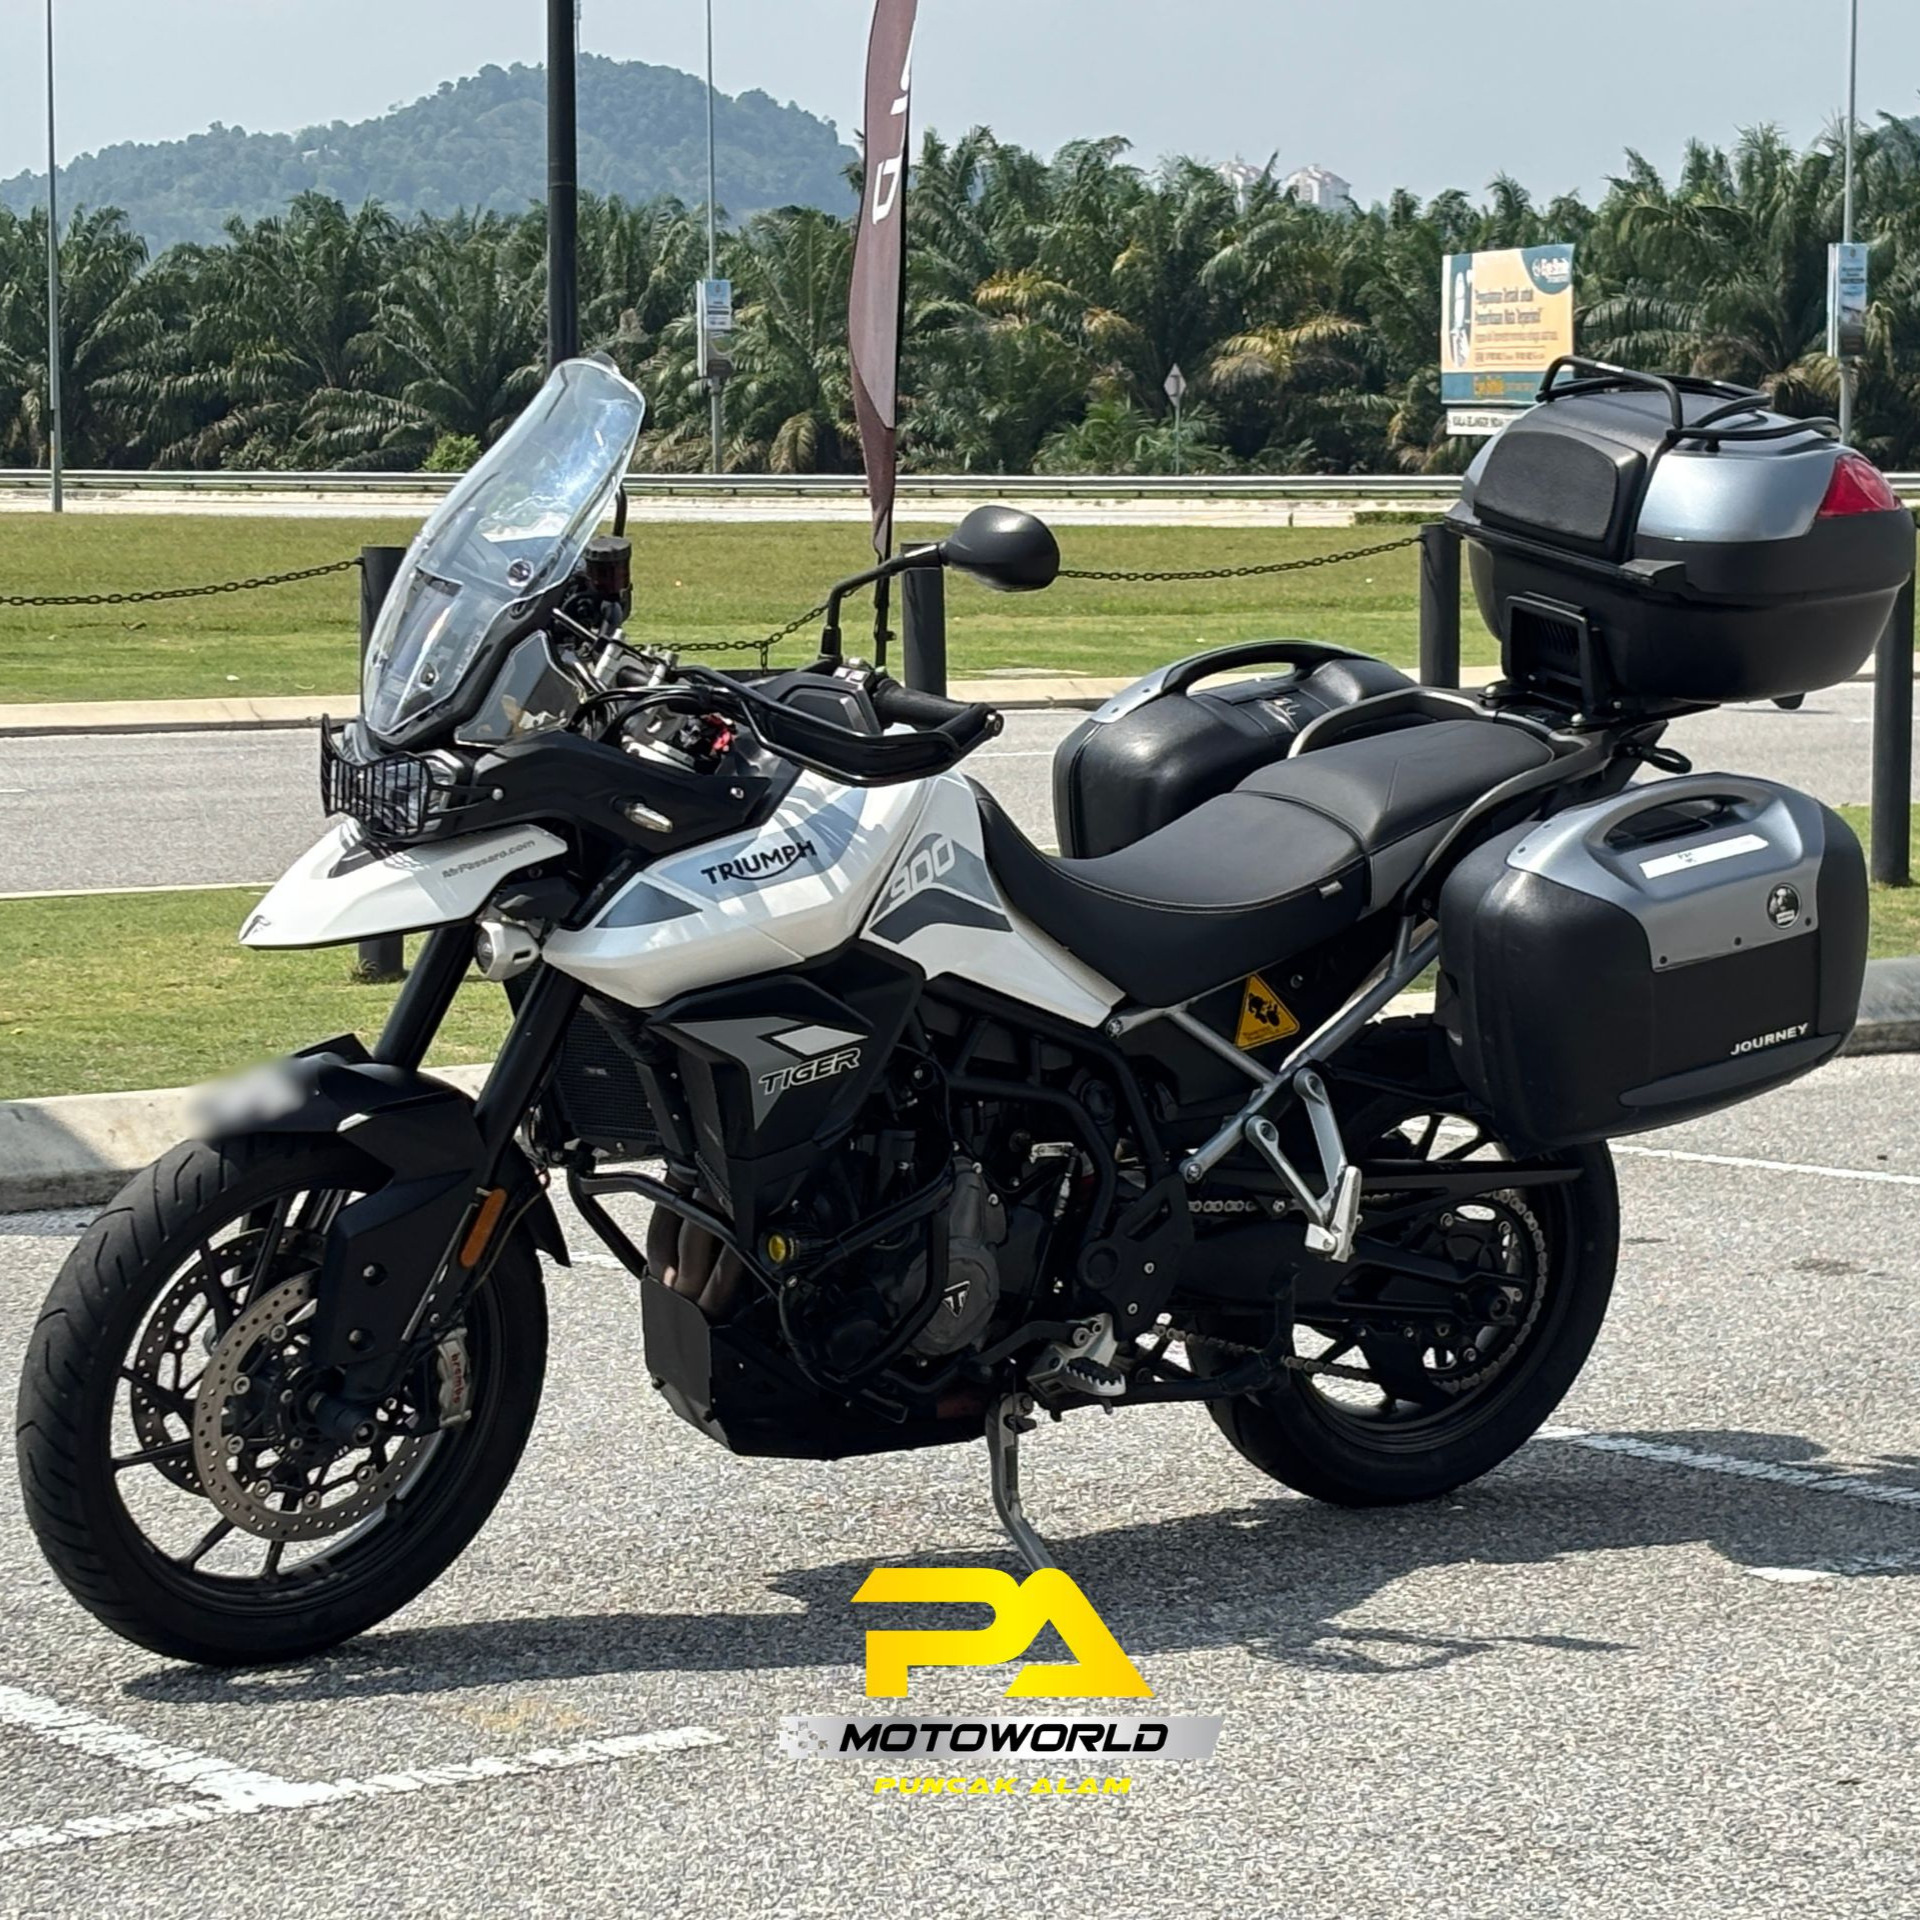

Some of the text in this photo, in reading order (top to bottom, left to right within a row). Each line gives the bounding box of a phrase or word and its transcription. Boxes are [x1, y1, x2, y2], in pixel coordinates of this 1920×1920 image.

[701, 840, 818, 885] TRIUMPH
[889, 838, 956, 900] 900
[1730, 1022, 1809, 1056] JOURNEY
[758, 1047, 861, 1096] TIGER
